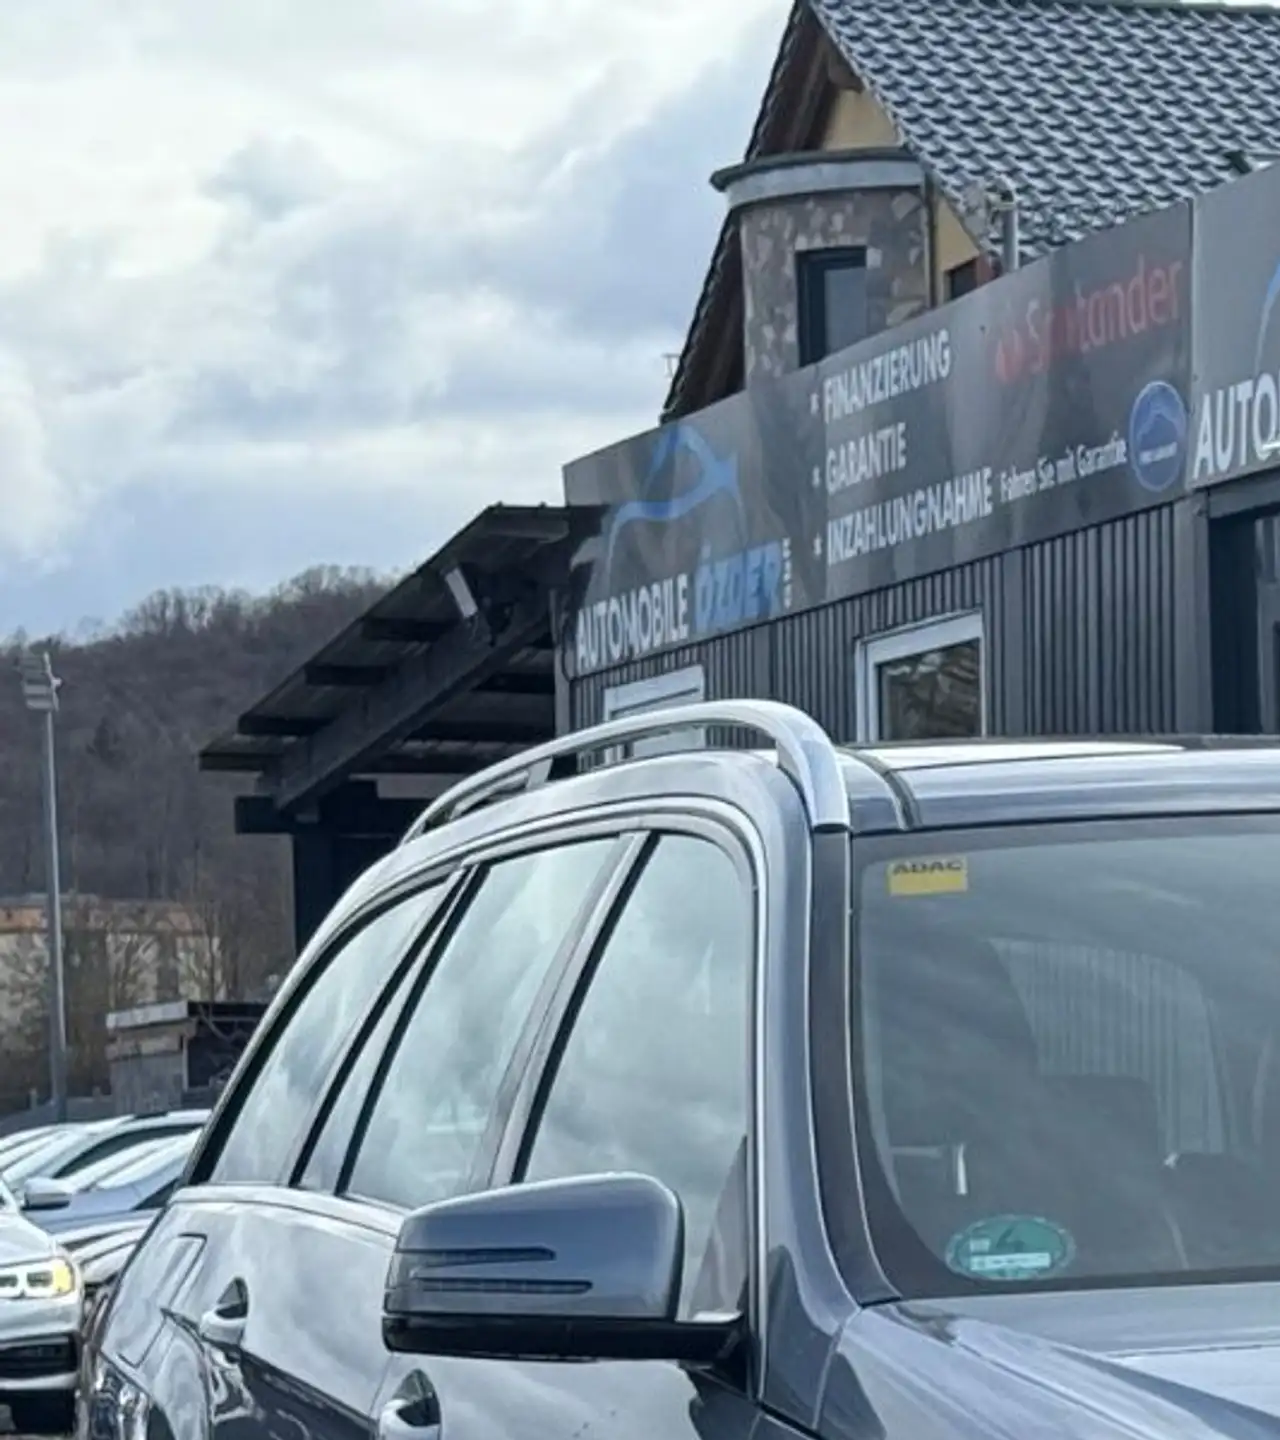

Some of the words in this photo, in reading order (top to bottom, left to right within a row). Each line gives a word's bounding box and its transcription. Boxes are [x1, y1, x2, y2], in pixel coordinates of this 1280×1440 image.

[824, 329, 951, 423] FINANZIERUNG
[825, 423, 907, 495] GARANTIE
[827, 467, 993, 566] INZAHLUNGNAHME
[575, 573, 689, 675] AUTOMOBILE
